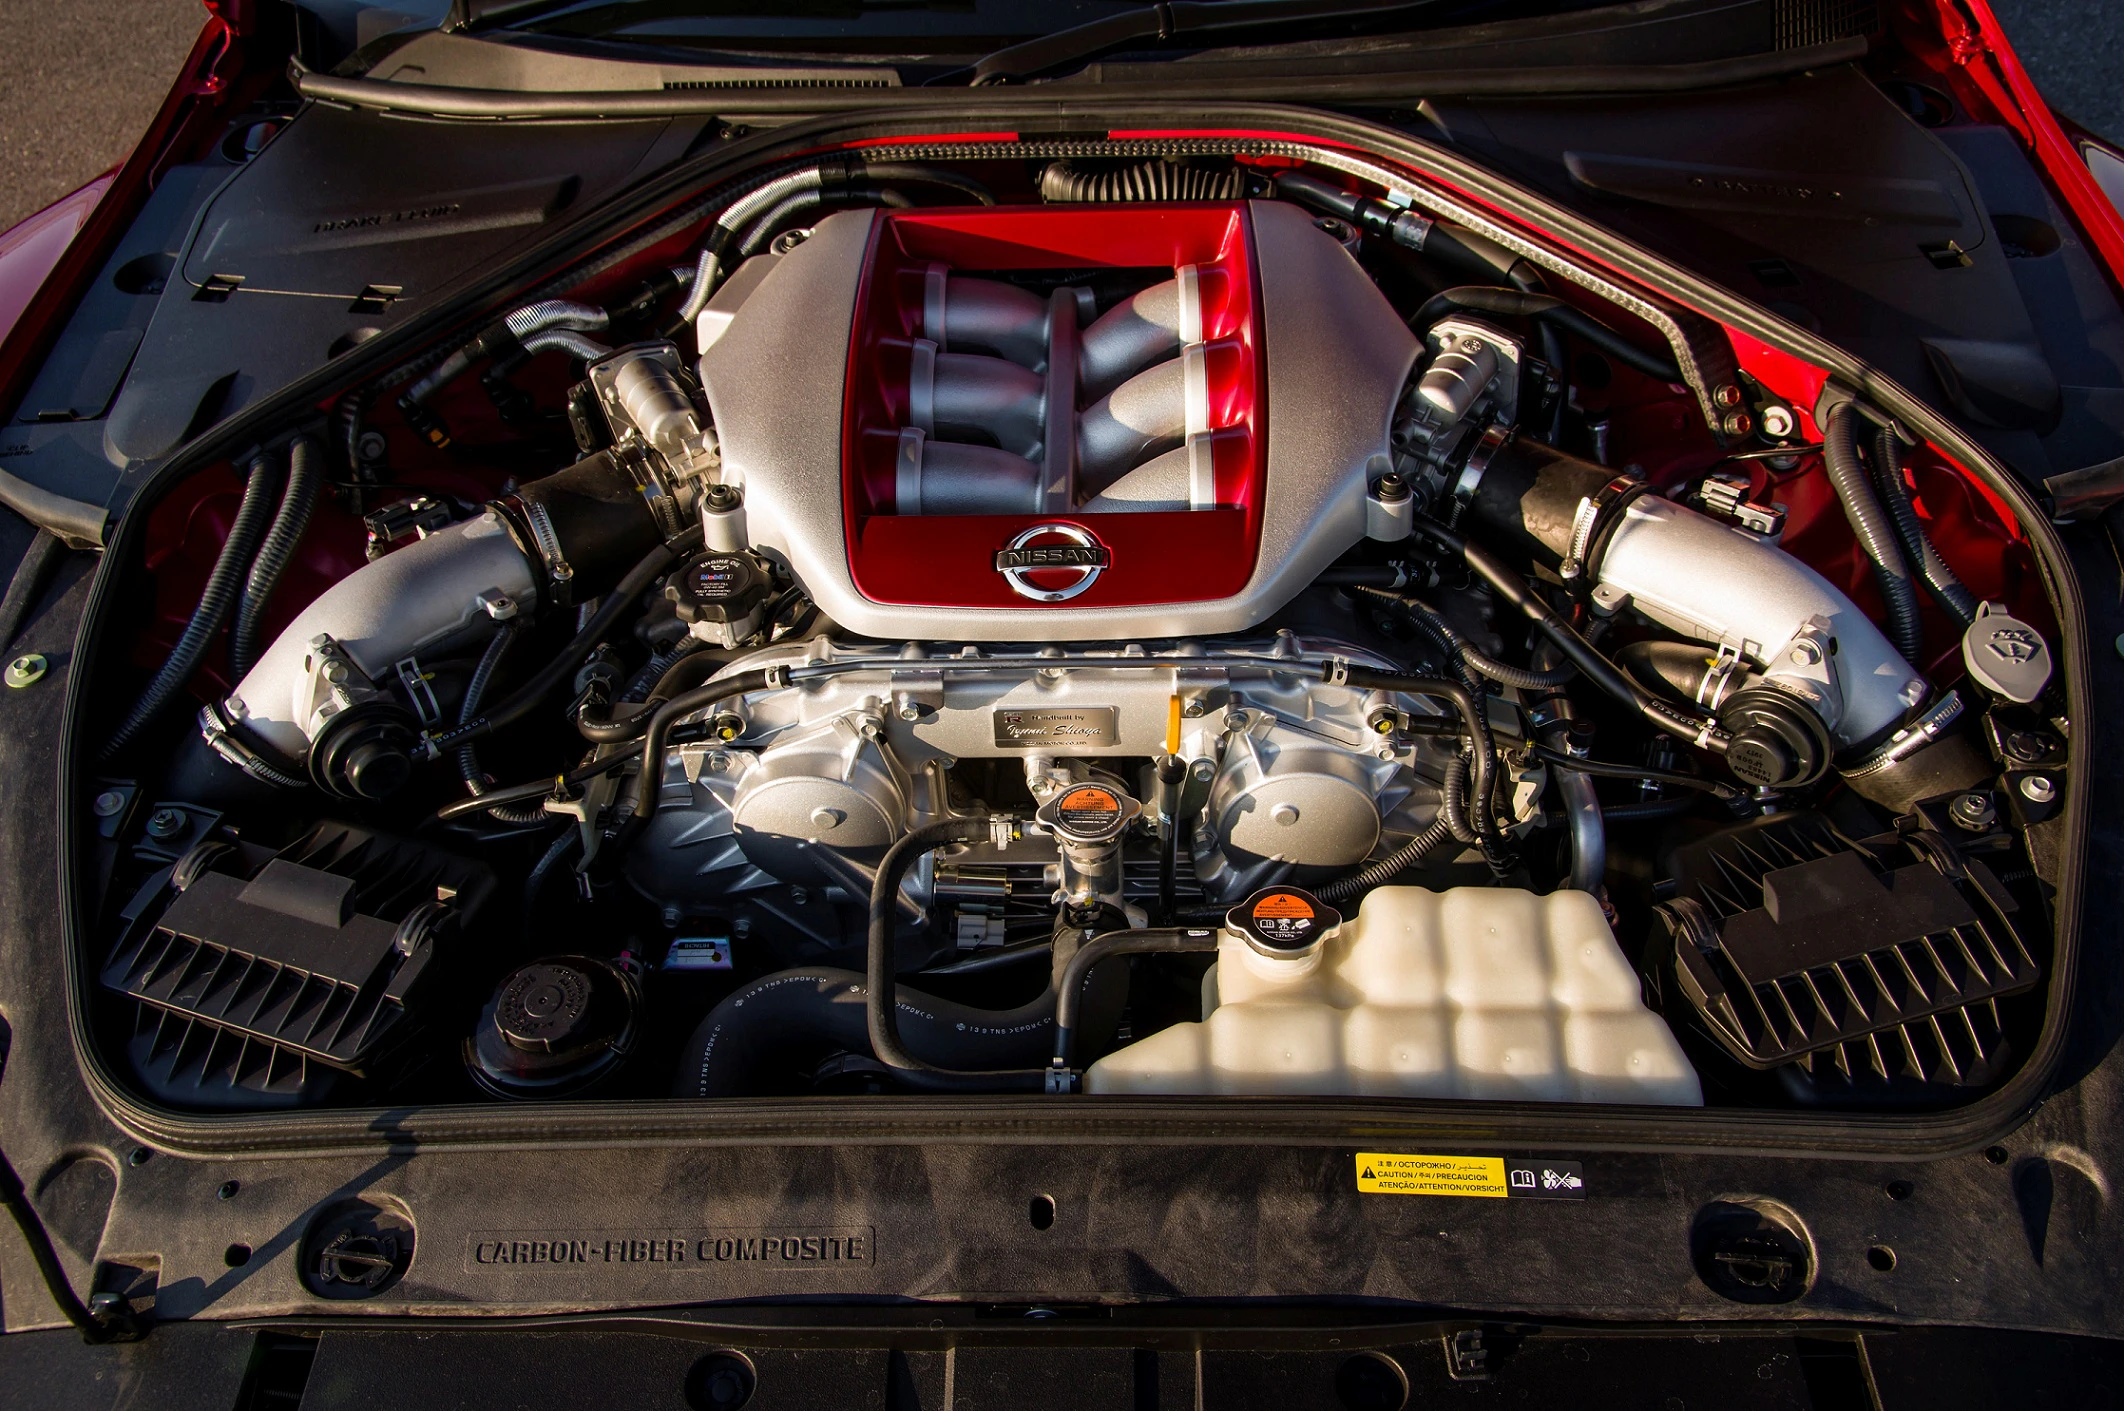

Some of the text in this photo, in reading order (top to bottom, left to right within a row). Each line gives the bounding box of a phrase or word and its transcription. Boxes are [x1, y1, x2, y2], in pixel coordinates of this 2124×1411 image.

[700, 559, 741, 568] ENGINE OIL
[1008, 549, 1097, 565] NISSAN
[1052, 723, 1102, 738] Shioya
[1734, 765, 1771, 783] NISSAN
[1398, 1161, 1452, 1170] ОСТОРОЖНО
[1377, 1171, 1414, 1179] CAUTION
[1436, 1173, 1488, 1181] PRECAUCION
[476, 1237, 864, 1264] CARBON-FIBER COMPOSITE
